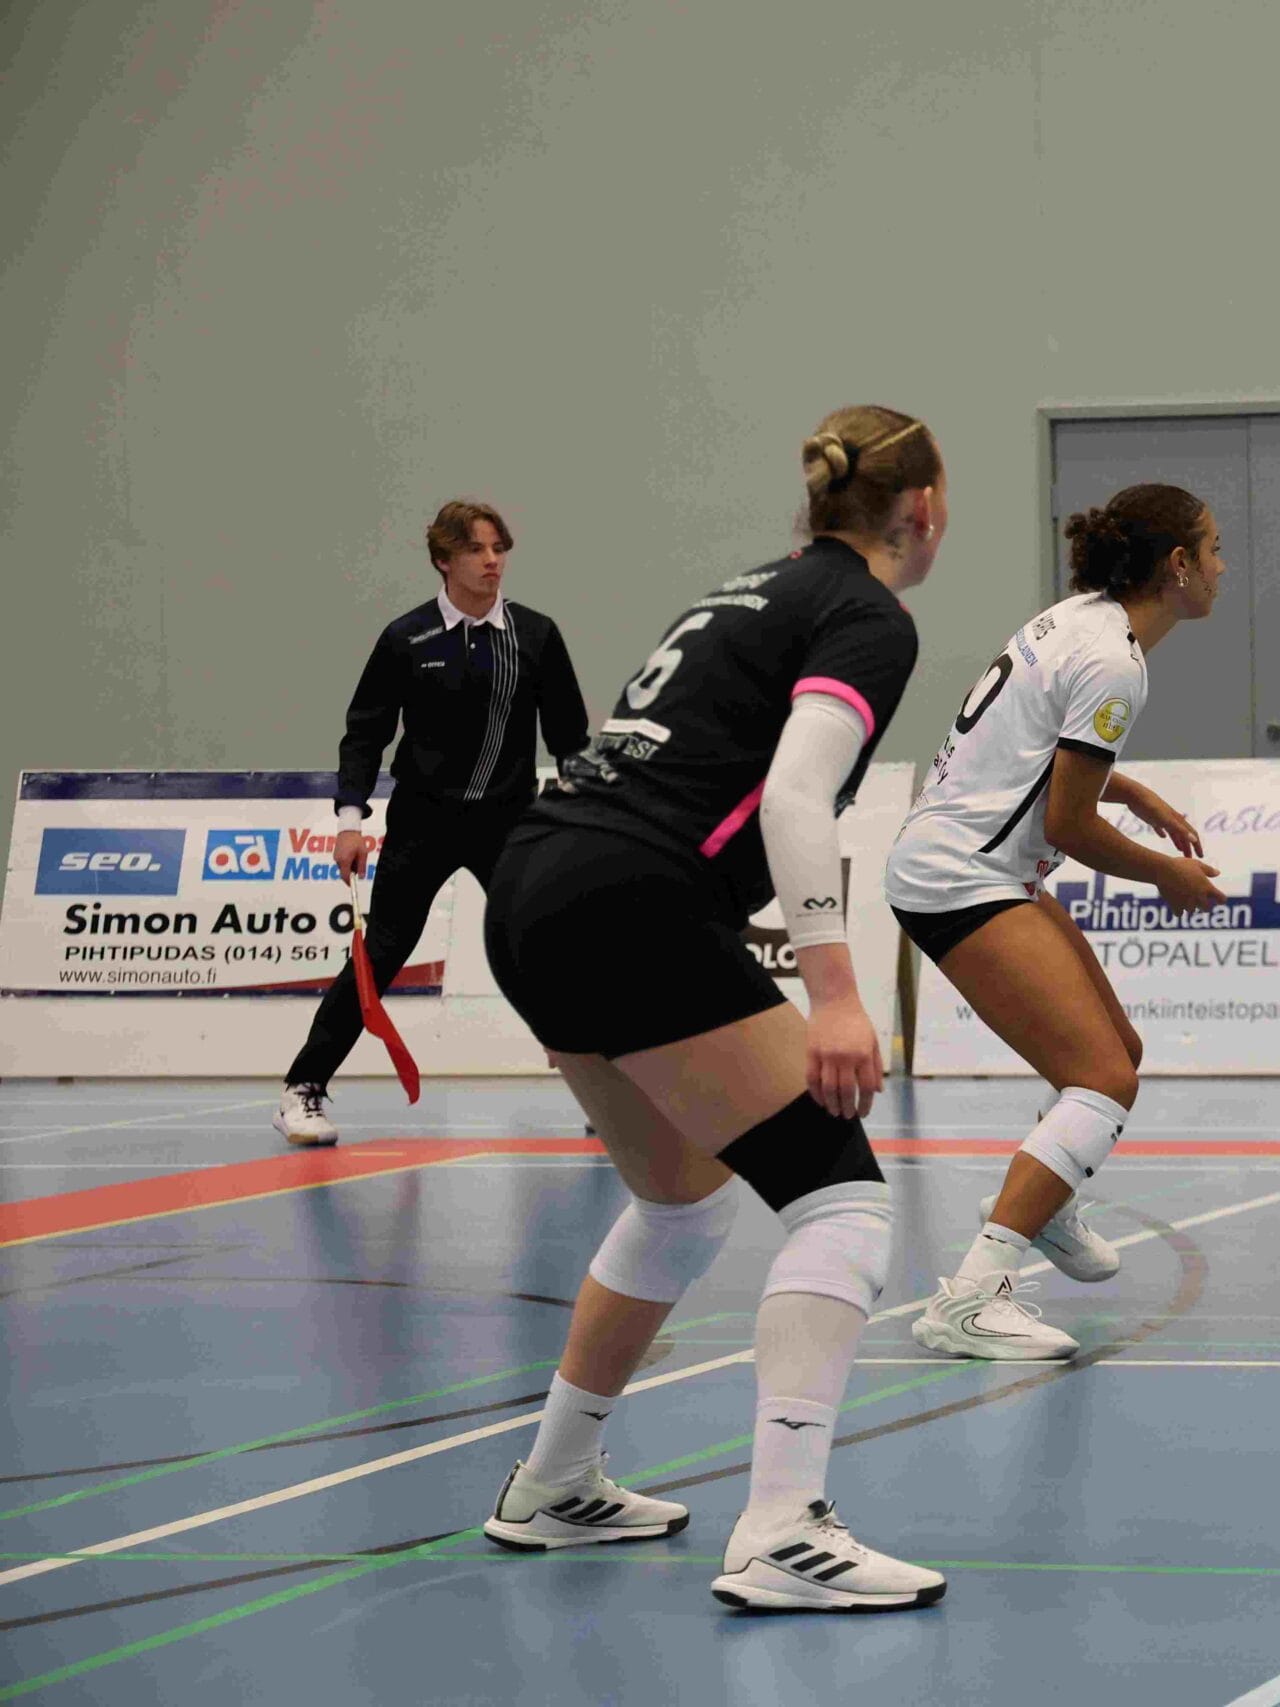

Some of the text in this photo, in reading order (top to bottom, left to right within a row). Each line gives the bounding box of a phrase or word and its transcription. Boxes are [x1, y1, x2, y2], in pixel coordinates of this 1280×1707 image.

[626, 611, 714, 710] 6
[955, 650, 1013, 735] 0
[63, 902, 198, 935] Simon
[211, 903, 317, 935] Auto
[1070, 901, 1252, 931] Pihtiputaan
[65, 945, 351, 964] PIHTIPUDAS (014) 561 1
[59, 967, 217, 985] www.simonauto.fi
